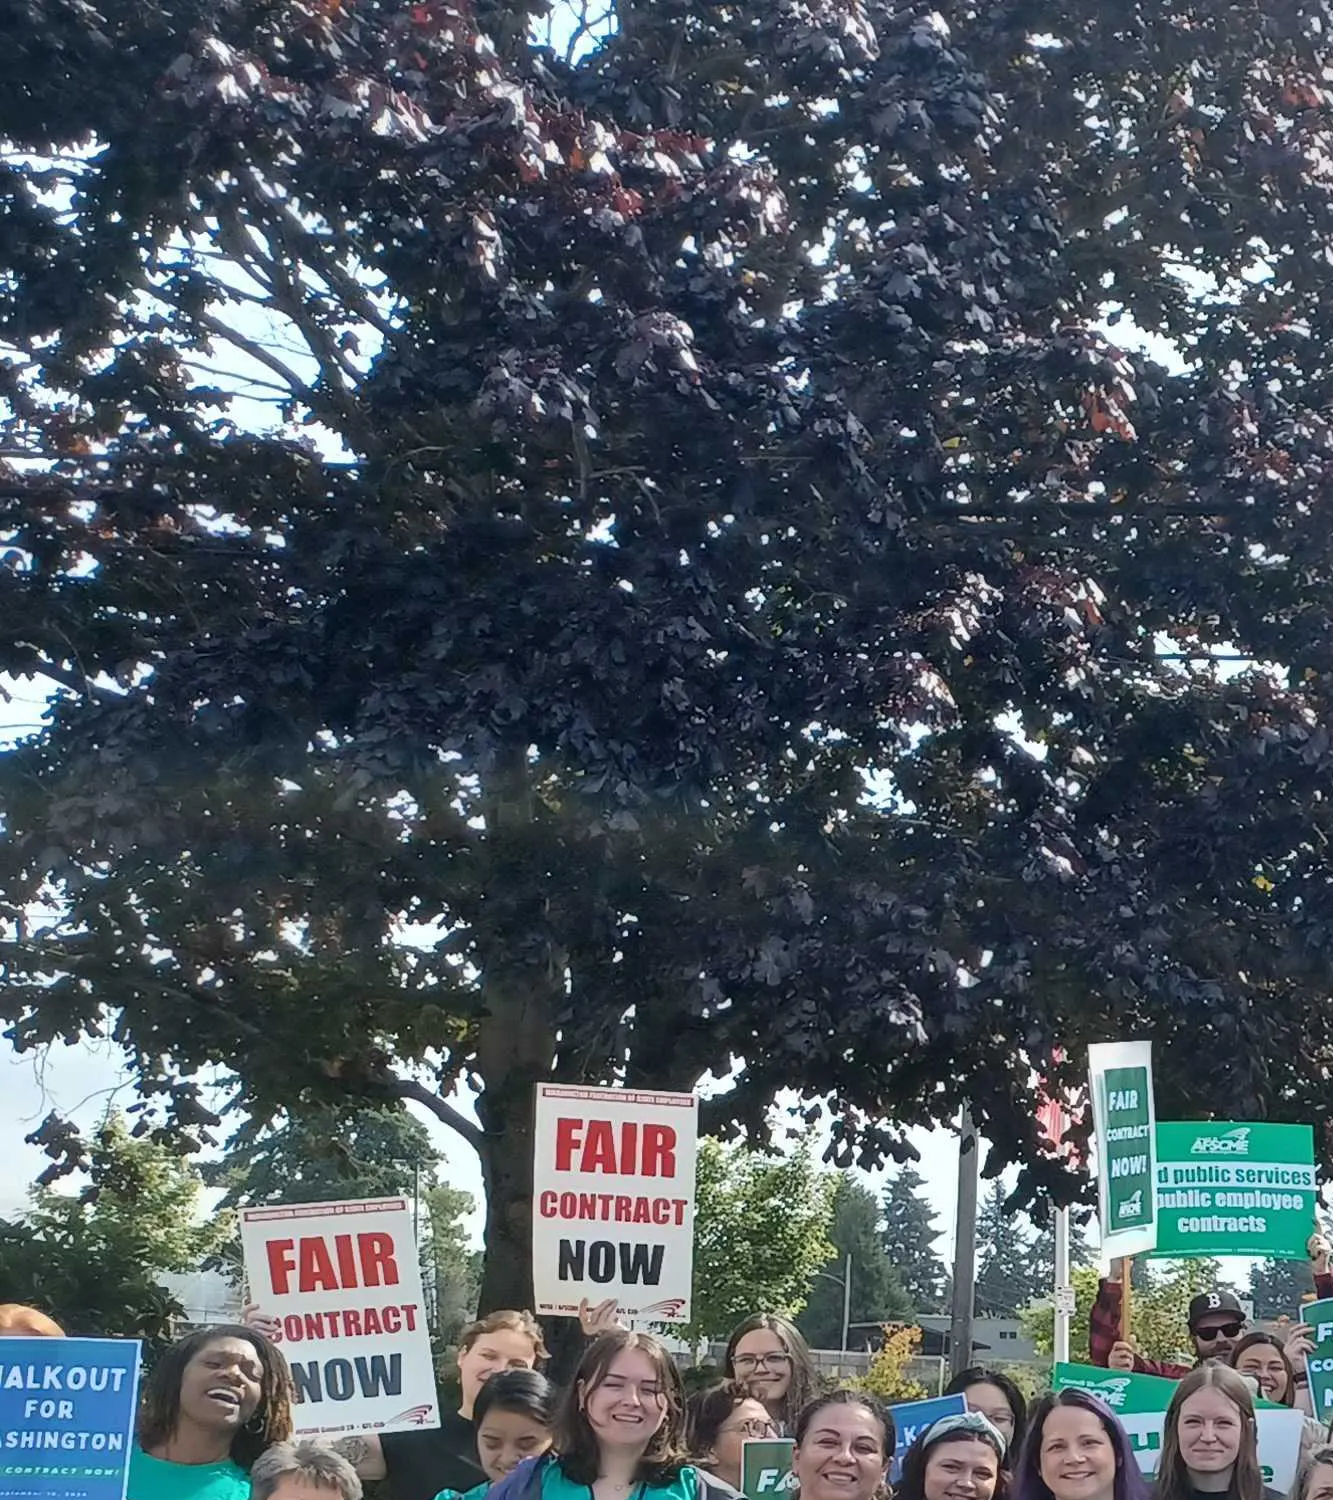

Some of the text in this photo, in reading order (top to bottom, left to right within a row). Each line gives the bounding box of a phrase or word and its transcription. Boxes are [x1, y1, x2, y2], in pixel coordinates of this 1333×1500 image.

[1108, 1089, 1138, 1111] FAIR
[1105, 1125, 1149, 1142] CONTRACT
[555, 1118, 676, 1178] FAIR
[1191, 1139, 1249, 1154] AFSCME
[1111, 1153, 1147, 1177] NOW!
[1173, 1162, 1311, 1186] public services
[540, 1190, 688, 1226] CONTRACT
[1215, 1191, 1303, 1211] employee
[1178, 1215, 1266, 1233] contracts
[266, 1232, 399, 1295] FAIR
[559, 1239, 665, 1285] NOW
[269, 1304, 417, 1343] CONTRACT
[0, 1365, 126, 1392] ALKOUT
[291, 1353, 402, 1404] NOW
[24, 1401, 73, 1419] FOR
[0, 1432, 122, 1450] SHINGTON
